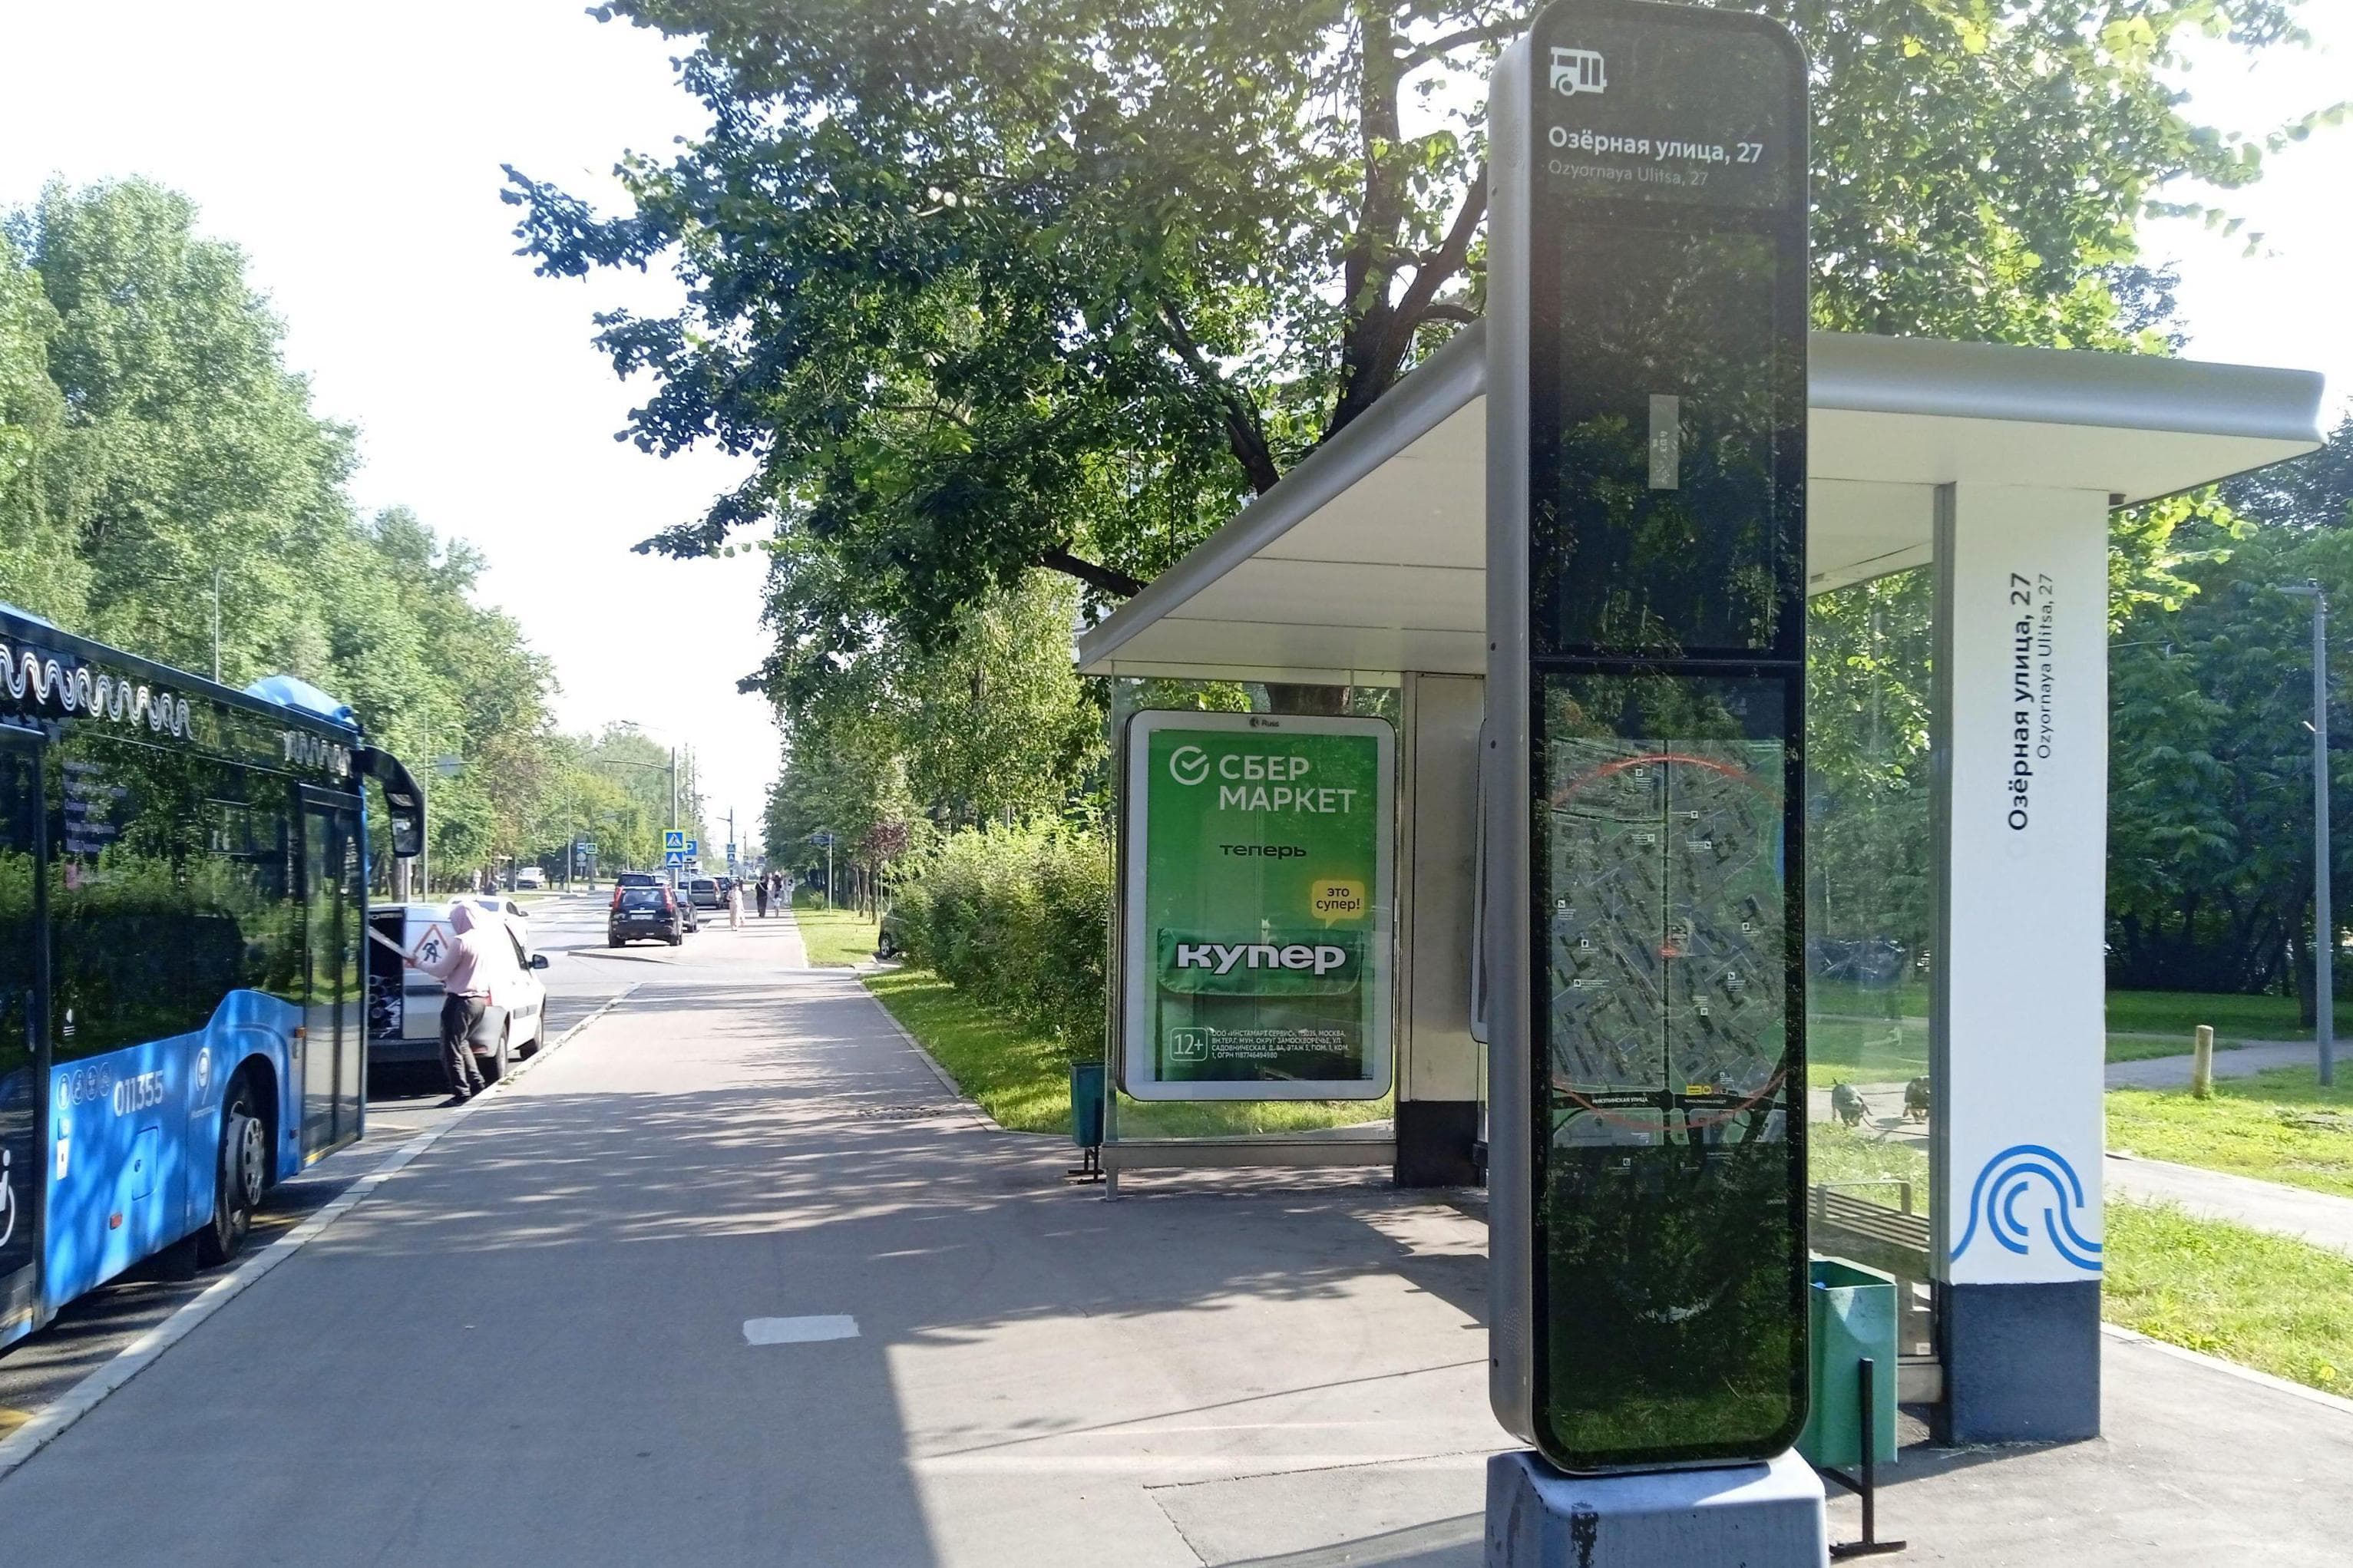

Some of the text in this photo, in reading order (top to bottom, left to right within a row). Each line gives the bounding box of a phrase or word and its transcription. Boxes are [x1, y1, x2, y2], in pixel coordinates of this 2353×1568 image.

[1548, 126, 1763, 166] Озёрная улица, 27
[1548, 160, 1709, 187] Ozyornaya Ulitsa, 27
[2037, 573, 2055, 759] Ozyornaya Ulitsa, 27
[2008, 572, 2035, 830] Озёрная улица, 27
[1218, 754, 1310, 781] СБЕР
[1219, 786, 1357, 814] МАРКЕТ
[1219, 844, 1307, 860] теперь
[1316, 897, 1361, 912] супер!
[1327, 887, 1350, 898] это
[1176, 943, 1347, 975] купер
[1174, 1034, 1203, 1055] 12+
[114, 1070, 164, 1117] 011355
